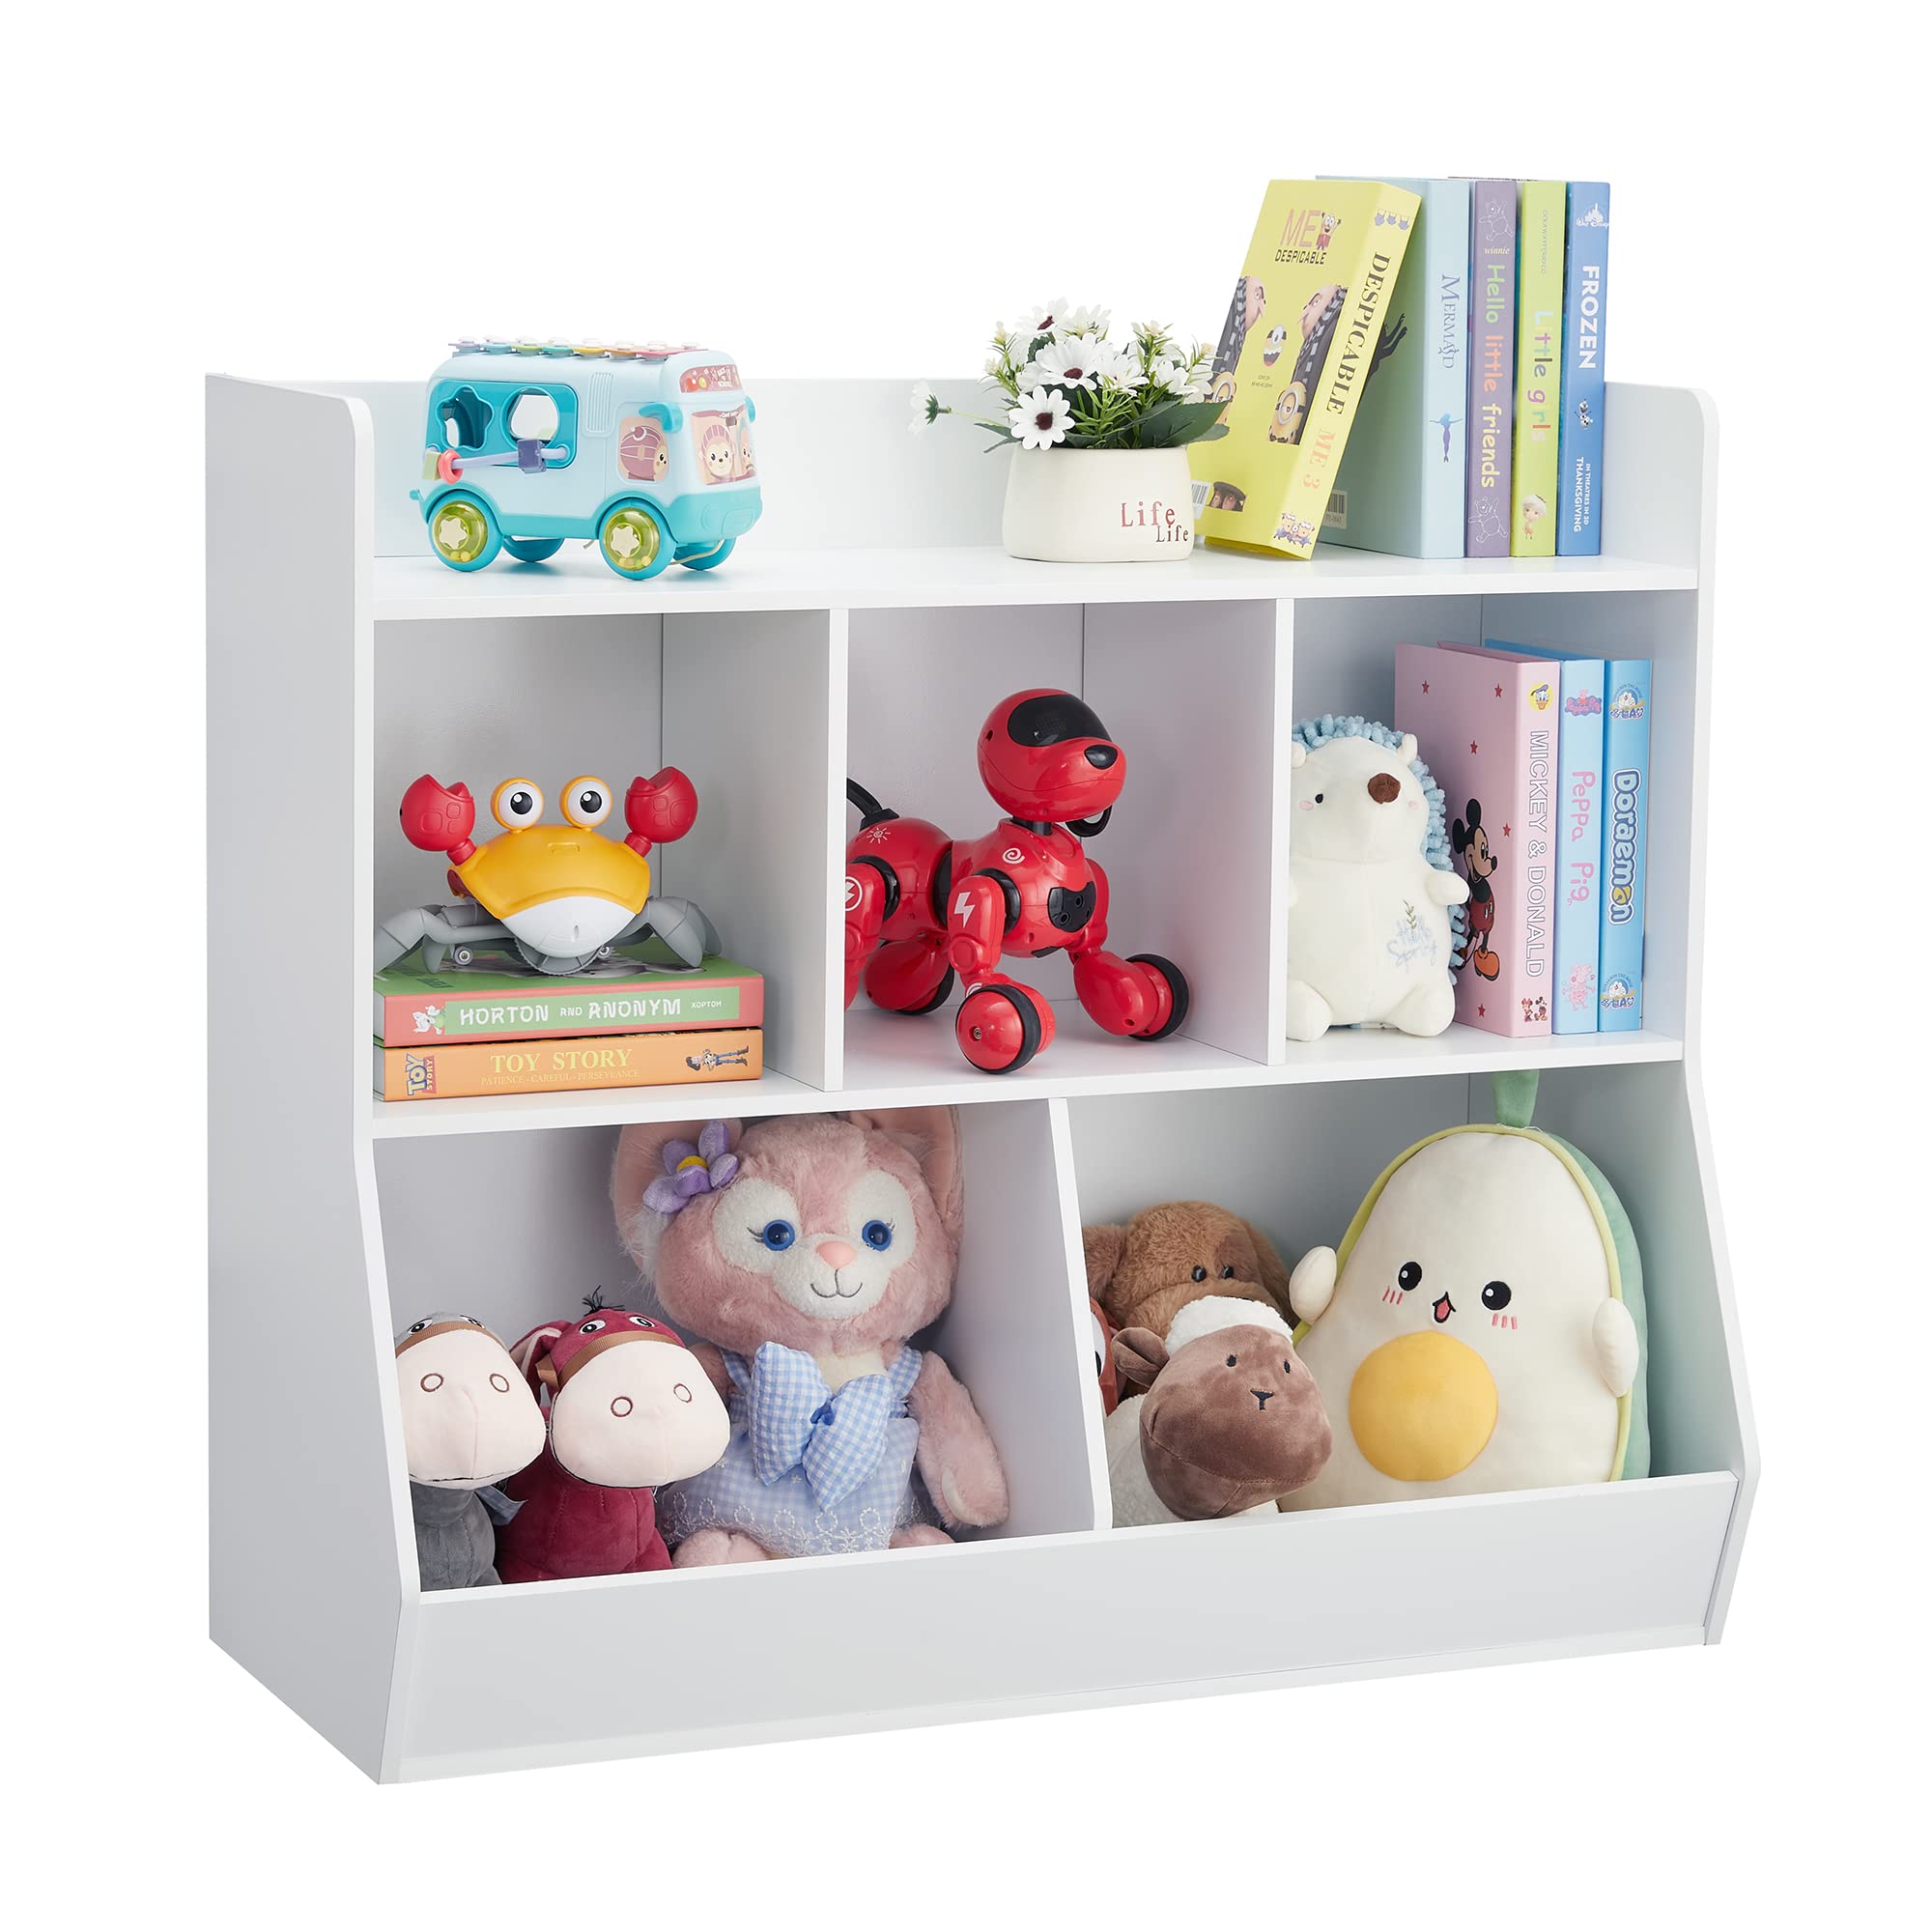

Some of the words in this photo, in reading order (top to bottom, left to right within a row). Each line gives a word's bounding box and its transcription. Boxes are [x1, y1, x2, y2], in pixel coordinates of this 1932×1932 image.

[1280, 208, 1322, 247] ME
[1274, 249, 1327, 265] DESPICABLE
[1484, 246, 1511, 255] winnie
[1486, 264, 1506, 324] Hello
[1326, 251, 1391, 414] DESPICABLE
[1578, 266, 1601, 369] FROZEN
[1484, 335, 1504, 392] little
[1310, 428, 1336, 469] ME
[1481, 403, 1502, 488] friends
[1303, 473, 1321, 490] 3
[1585, 463, 1591, 471] IN
[1122, 500, 1176, 527] Life
[1574, 456, 1584, 532] THANKSGIVING
[1155, 525, 1189, 543] Life
[1528, 730, 1549, 833] MICKEY
[1571, 770, 1596, 842] Peppa
[1527, 839, 1548, 859] &
[1609, 769, 1641, 924] Doraemon
[1569, 862, 1595, 902] Pig
[1525, 866, 1547, 978] DONALD
[460, 1005, 550, 1026] HORTON
[587, 998, 681, 1020] ANONYM
[406, 1053, 428, 1095] TOY
[481, 1074, 525, 1086] PATIENCE
[530, 1072, 573, 1083] CAREFUL
[490, 1053, 541, 1073] TOY
[553, 1048, 634, 1070] STORY
